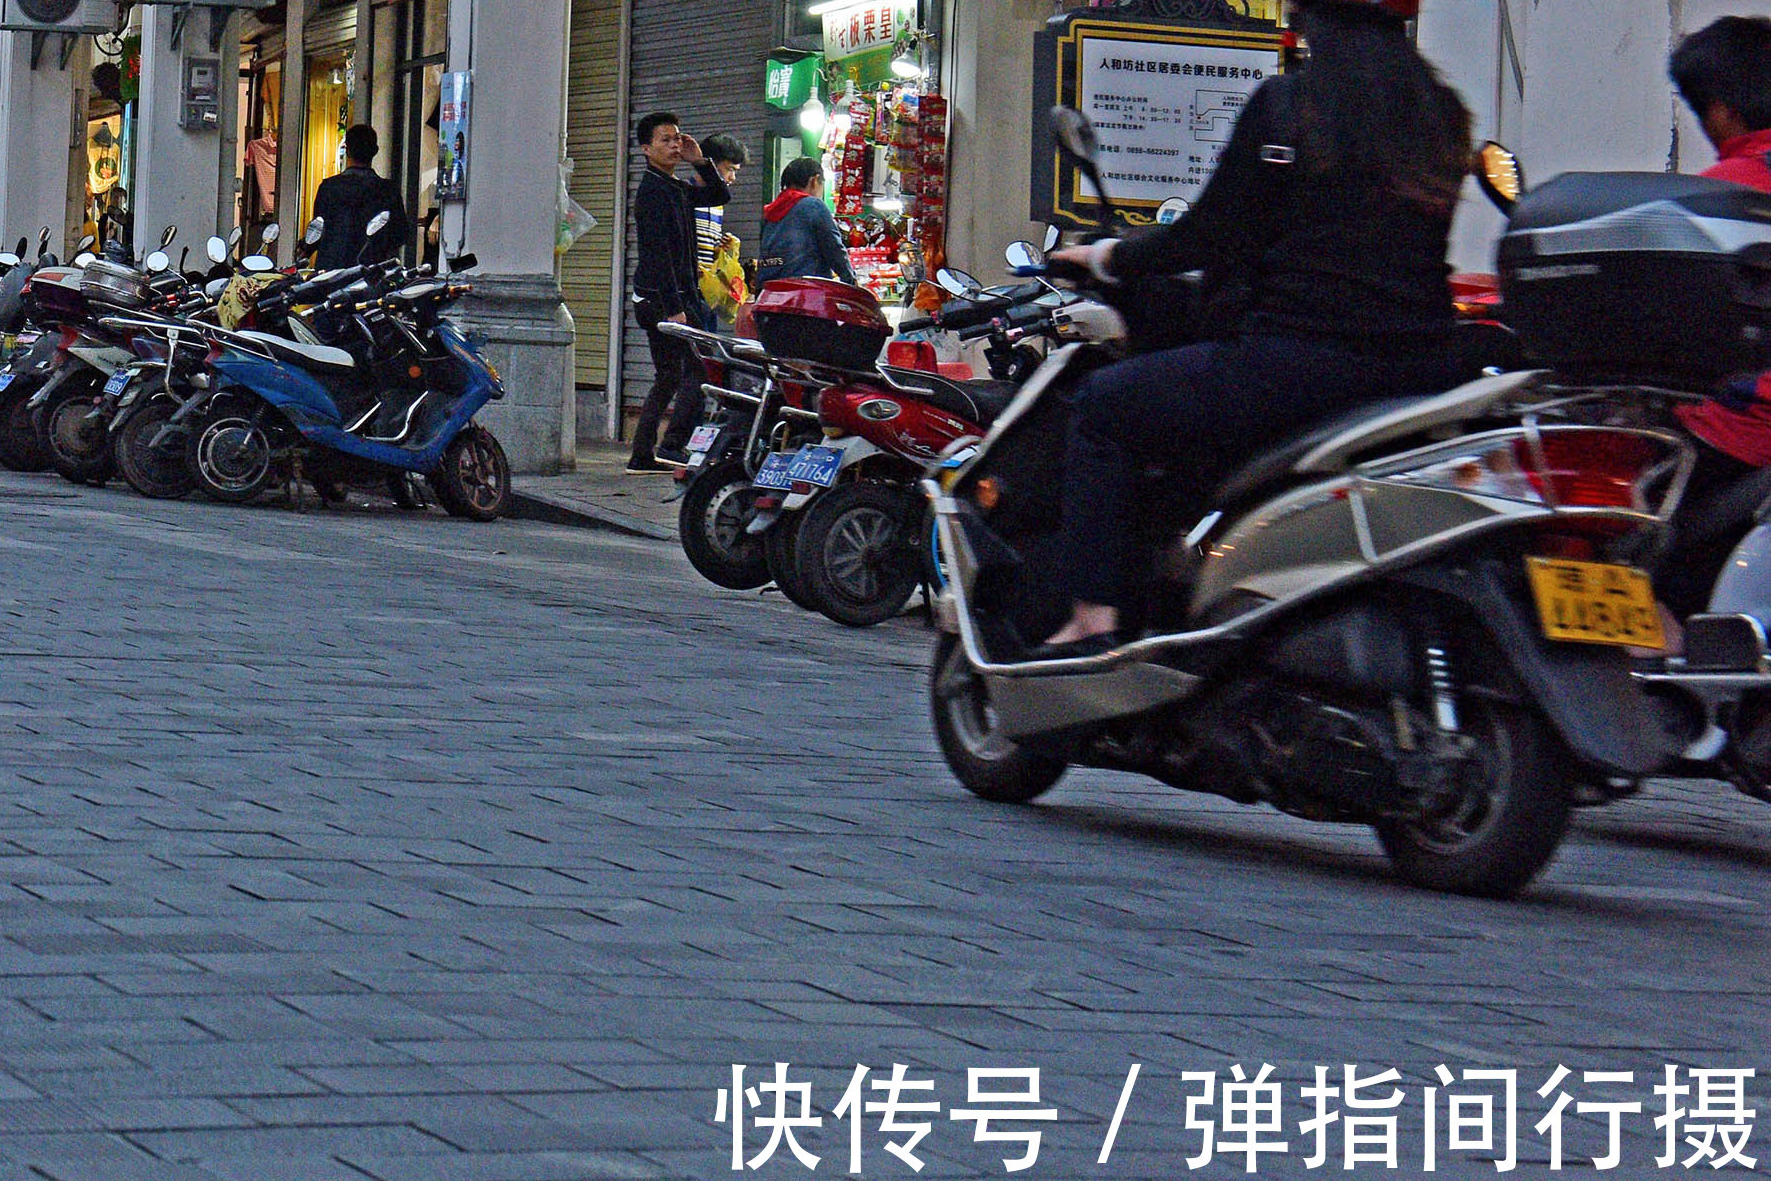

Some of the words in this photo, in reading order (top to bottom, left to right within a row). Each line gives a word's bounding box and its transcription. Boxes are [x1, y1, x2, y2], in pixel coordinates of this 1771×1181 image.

[1099, 57, 1264, 80] 人和坊社区居委会便民服务中心
